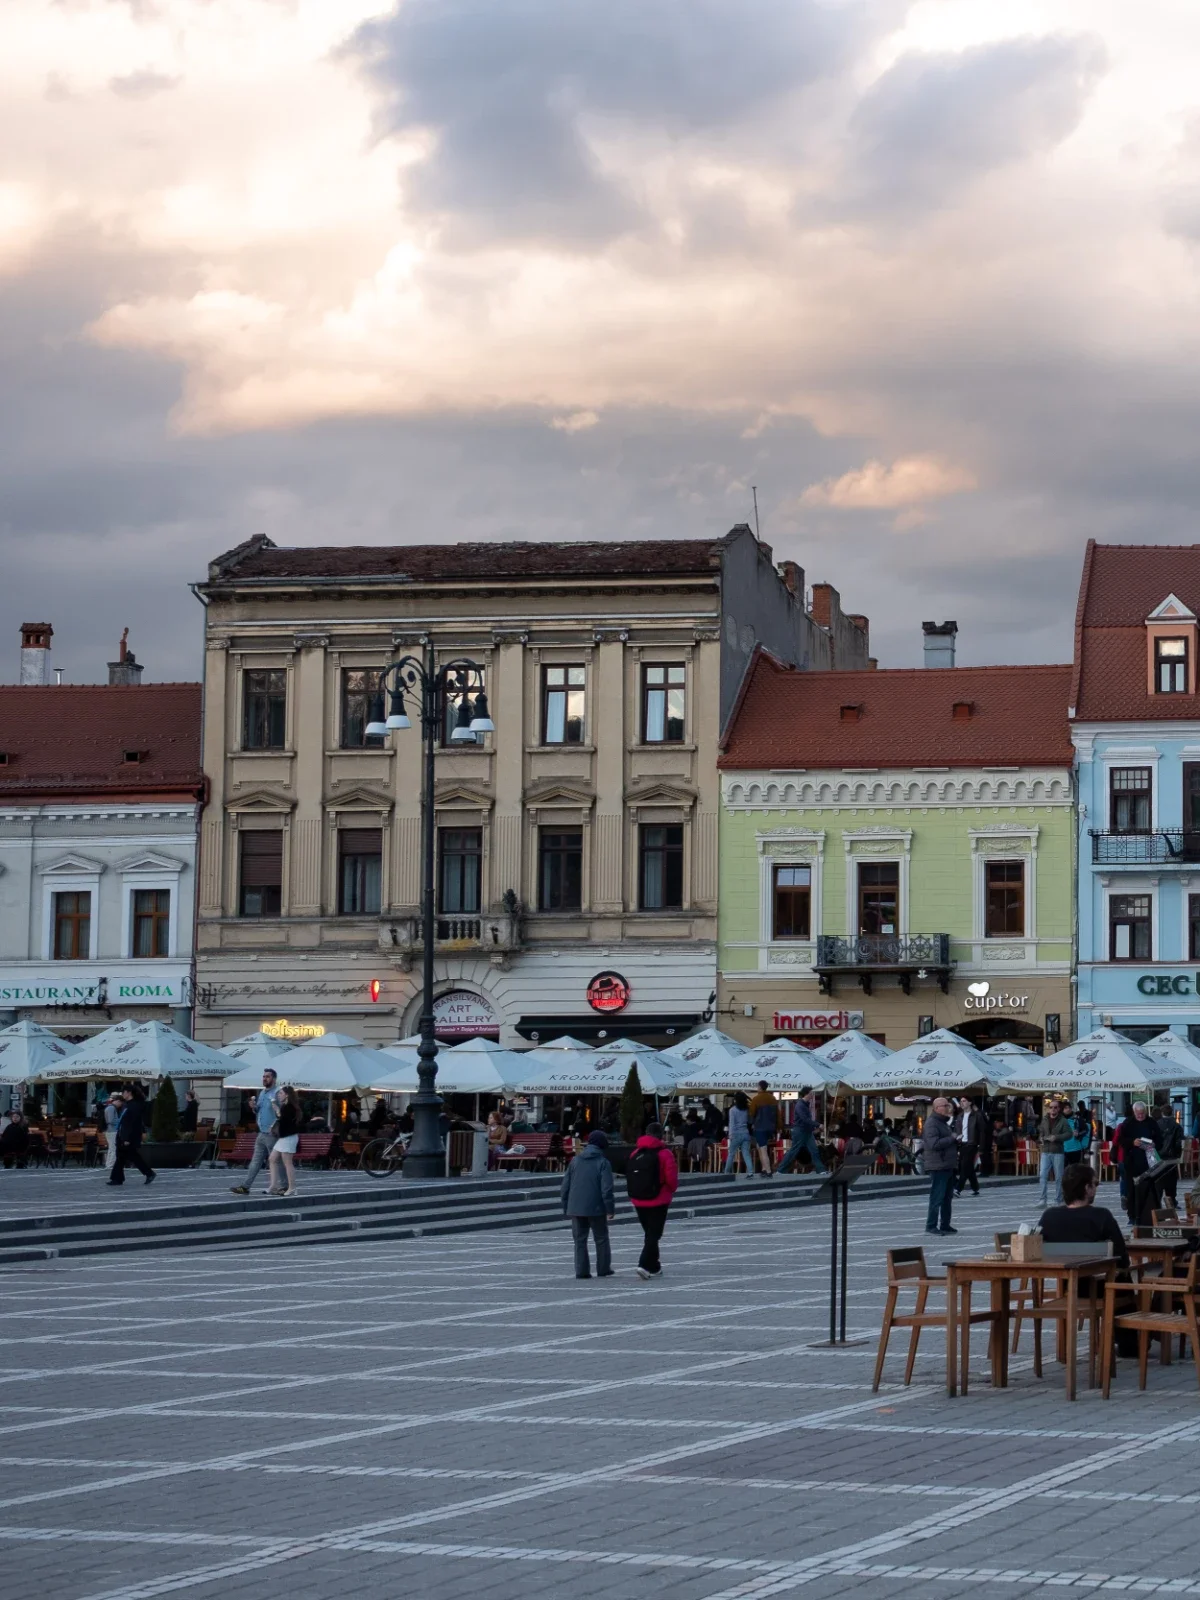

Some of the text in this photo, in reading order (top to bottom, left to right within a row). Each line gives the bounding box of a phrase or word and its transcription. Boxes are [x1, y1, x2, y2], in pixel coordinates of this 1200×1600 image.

[1137, 975, 1190, 995] CEC
[0, 985, 173, 999] STAURANT ROMA
[432, 993, 494, 1013] RANSILVANIA
[448, 1004, 472, 1013] ART
[773, 1010, 863, 1029] inmedio
[711, 1071, 801, 1079] KRONSTADT
[873, 1067, 962, 1077] KRONSTADT
[1152, 1228, 1183, 1238] Kozel
